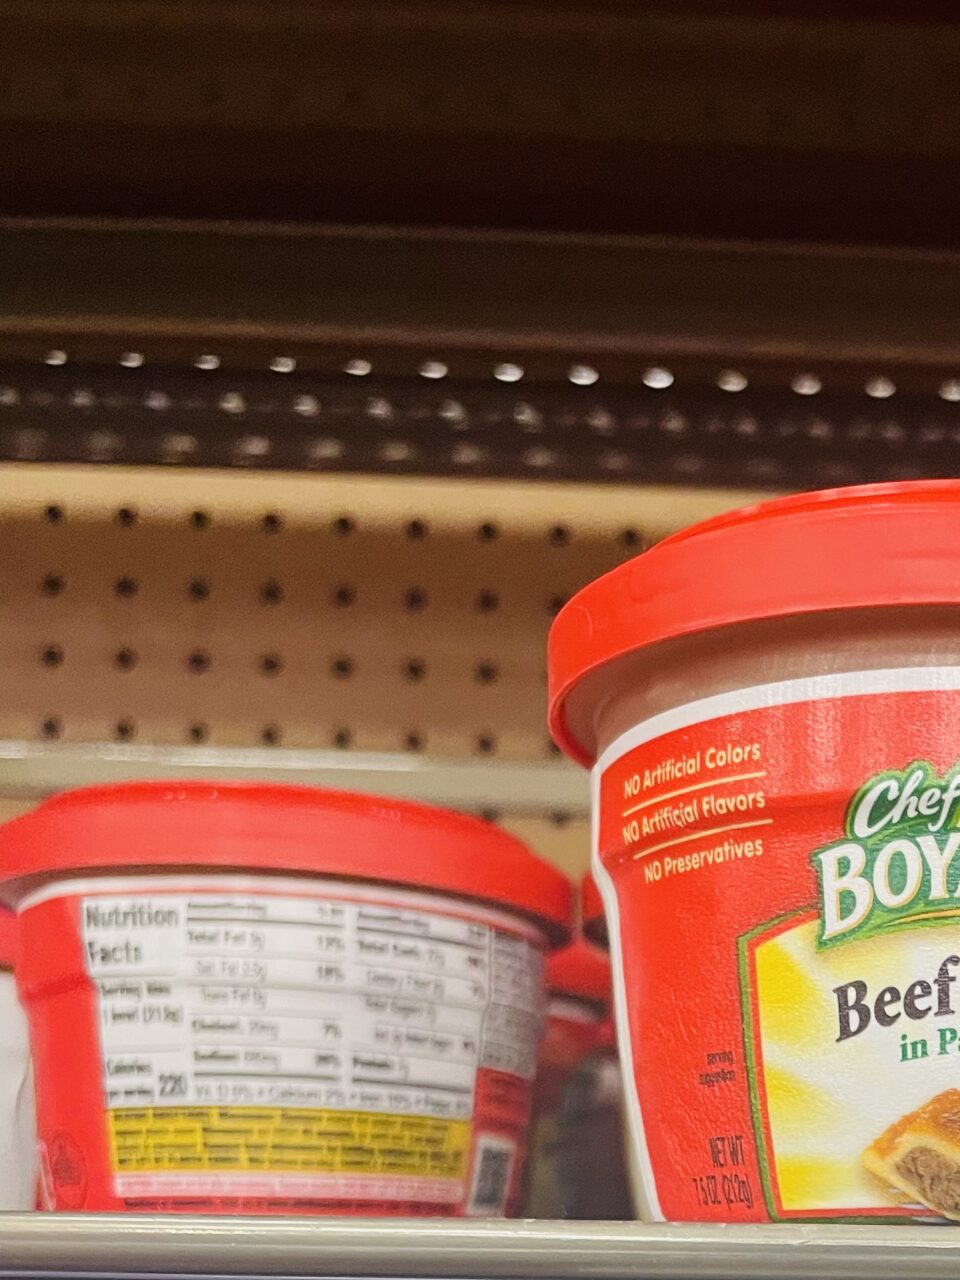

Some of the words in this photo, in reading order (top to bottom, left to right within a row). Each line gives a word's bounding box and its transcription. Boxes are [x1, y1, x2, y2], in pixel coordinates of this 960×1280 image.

[624, 773, 641, 799] NO
[643, 752, 700, 790] Artificial
[705, 741, 761, 769] Colors
[623, 819, 640, 845] NO
[642, 800, 699, 836] Artificial
[703, 789, 765, 816] Flavors
[644, 859, 662, 884] NO
[664, 838, 763, 875] Preservatives
[833, 955, 960, 1043] Beef
[900, 1033, 930, 1062] in
[709, 1137, 727, 1168] NET
[727, 1135, 745, 1166] WT
